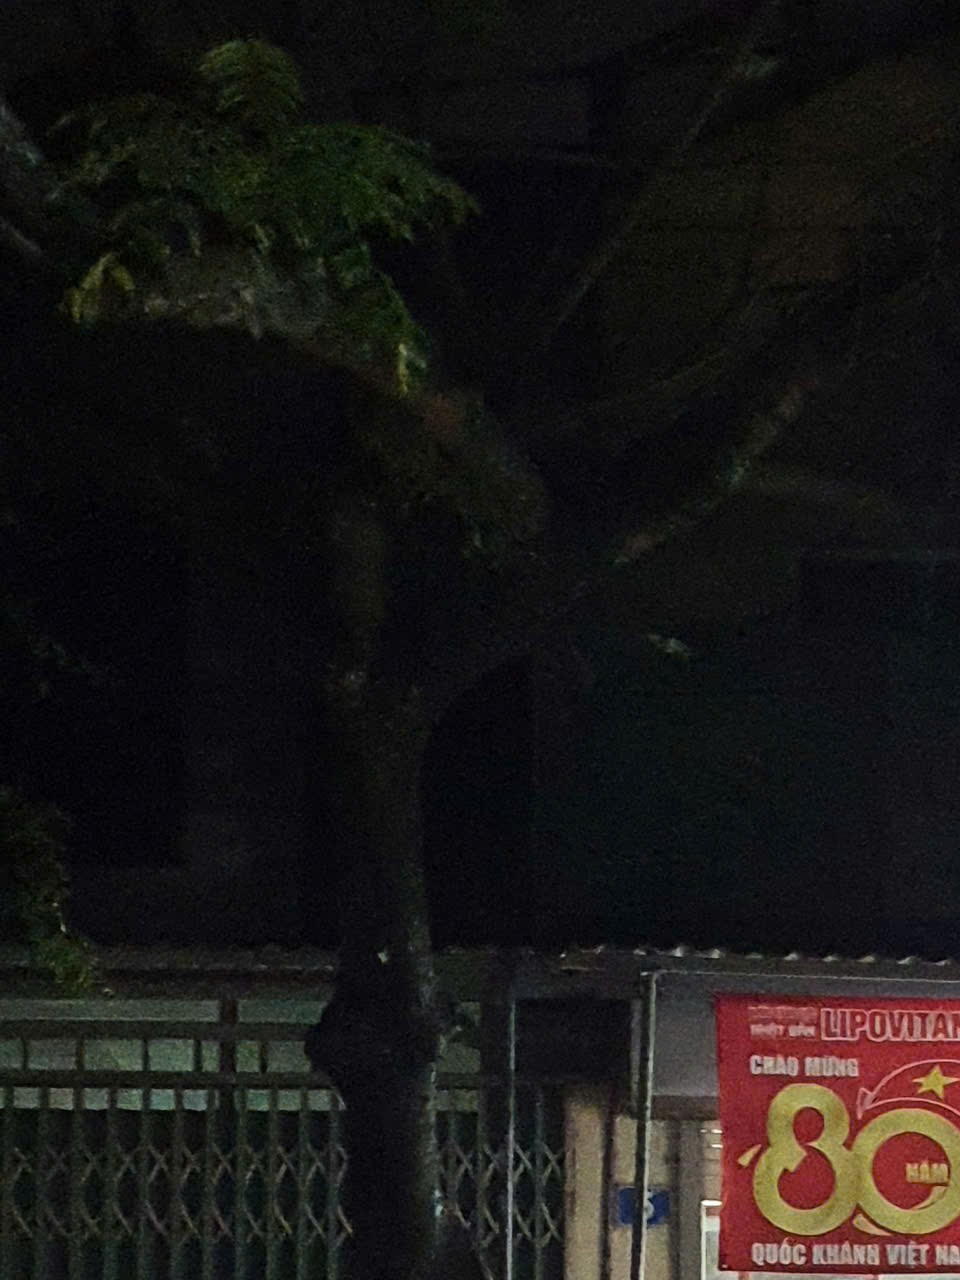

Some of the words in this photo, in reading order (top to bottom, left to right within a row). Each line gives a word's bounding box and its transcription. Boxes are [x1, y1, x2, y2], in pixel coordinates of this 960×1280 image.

[751, 1237, 806, 1266] QUỐC
[813, 1240, 880, 1265] KHÁNH
[886, 1240, 929, 1267] VIỆT
